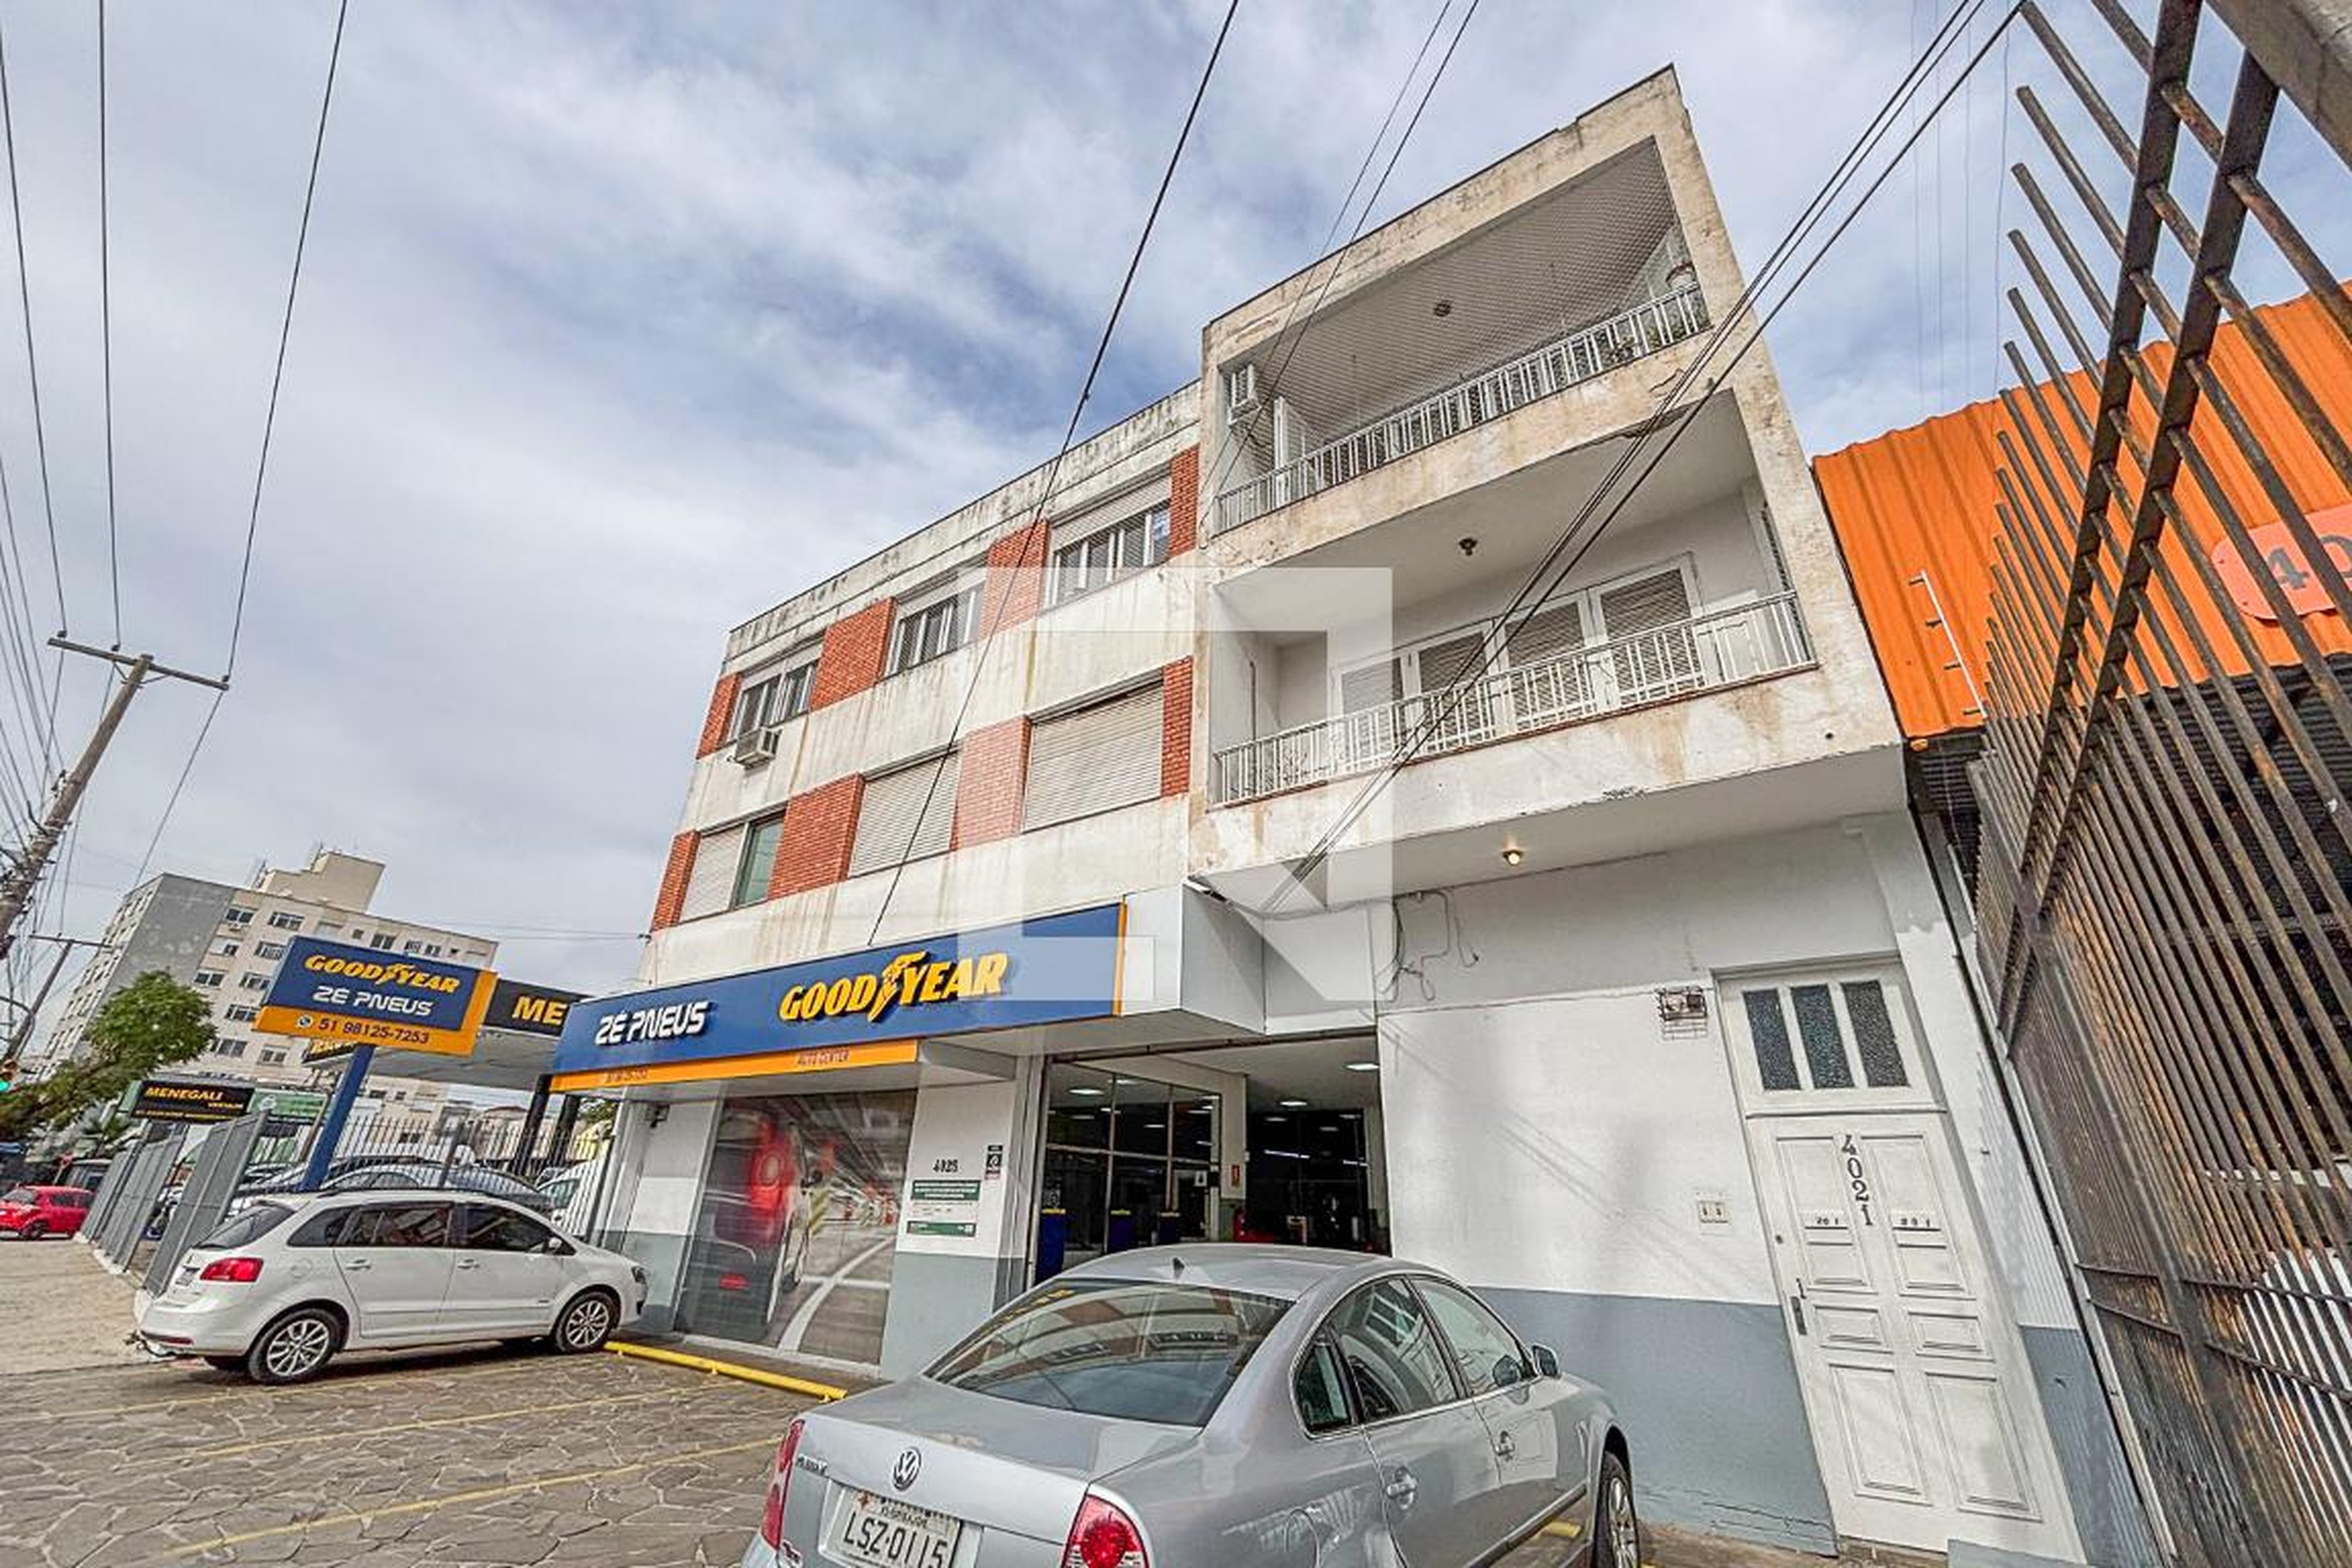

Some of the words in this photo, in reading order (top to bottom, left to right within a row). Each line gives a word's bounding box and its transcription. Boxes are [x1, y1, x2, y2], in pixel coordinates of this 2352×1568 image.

[304, 955, 460, 993] GOODYEAR
[779, 952, 1007, 1022] GOODYEAR
[353, 992, 434, 1016] PNEUS
[626, 1000, 709, 1041] PNEUS
[318, 1018, 337, 1032] 51
[343, 1022, 430, 1044] 98125-7253
[1842, 1134, 1872, 1225] 4021
